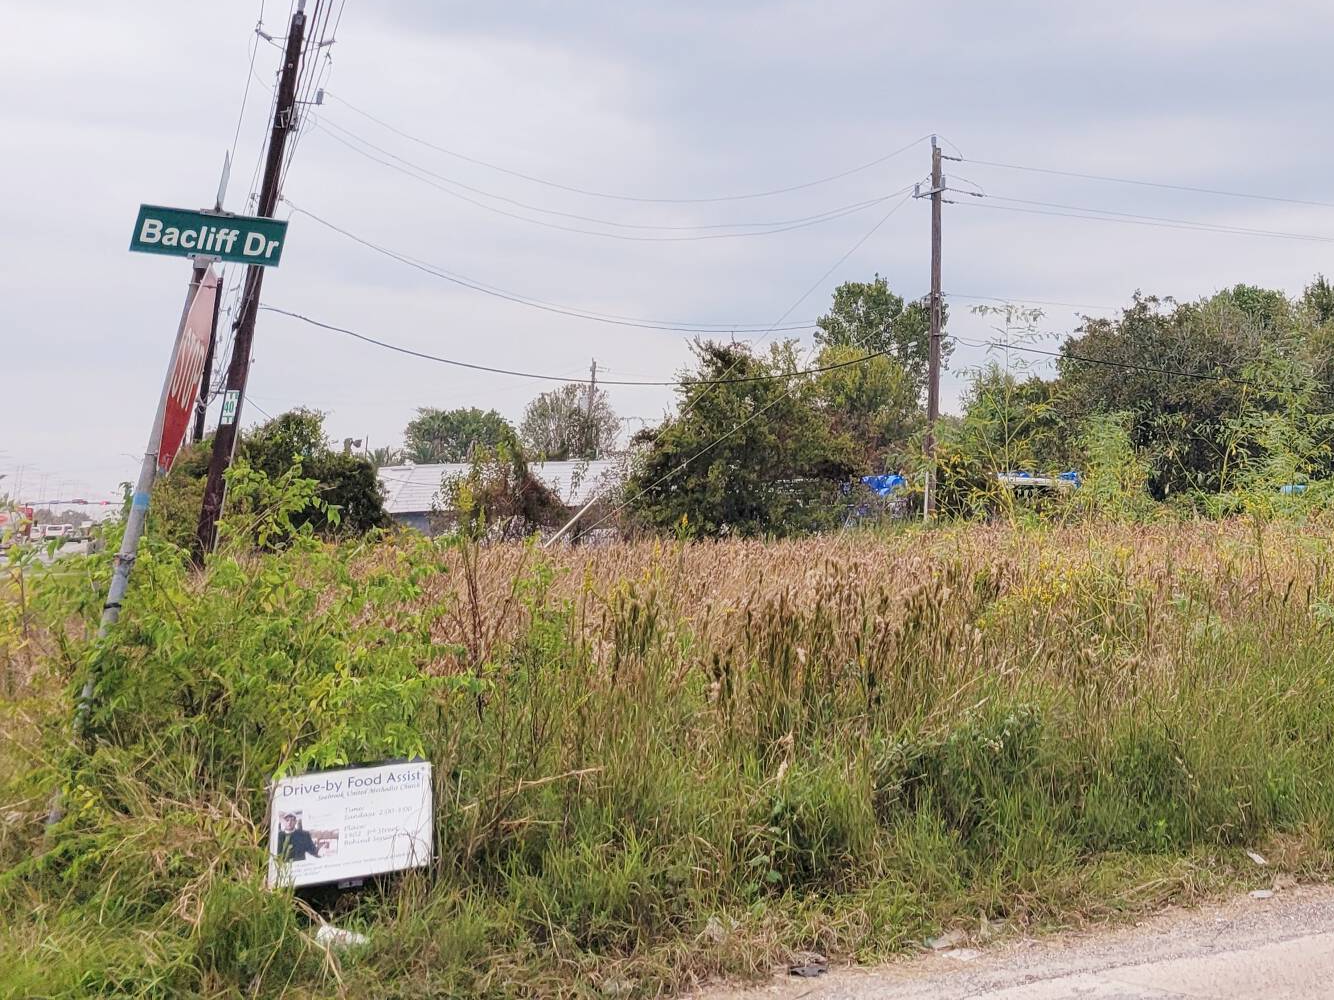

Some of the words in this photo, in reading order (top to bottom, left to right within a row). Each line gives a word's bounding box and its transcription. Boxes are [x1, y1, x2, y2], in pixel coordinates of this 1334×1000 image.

[140, 218, 239, 253] Bacliff
[243, 231, 279, 258] Dr
[171, 327, 205, 412] STOP
[283, 779, 342, 797] Drive-by
[348, 773, 381, 789] Food
[387, 770, 420, 784] Assist
